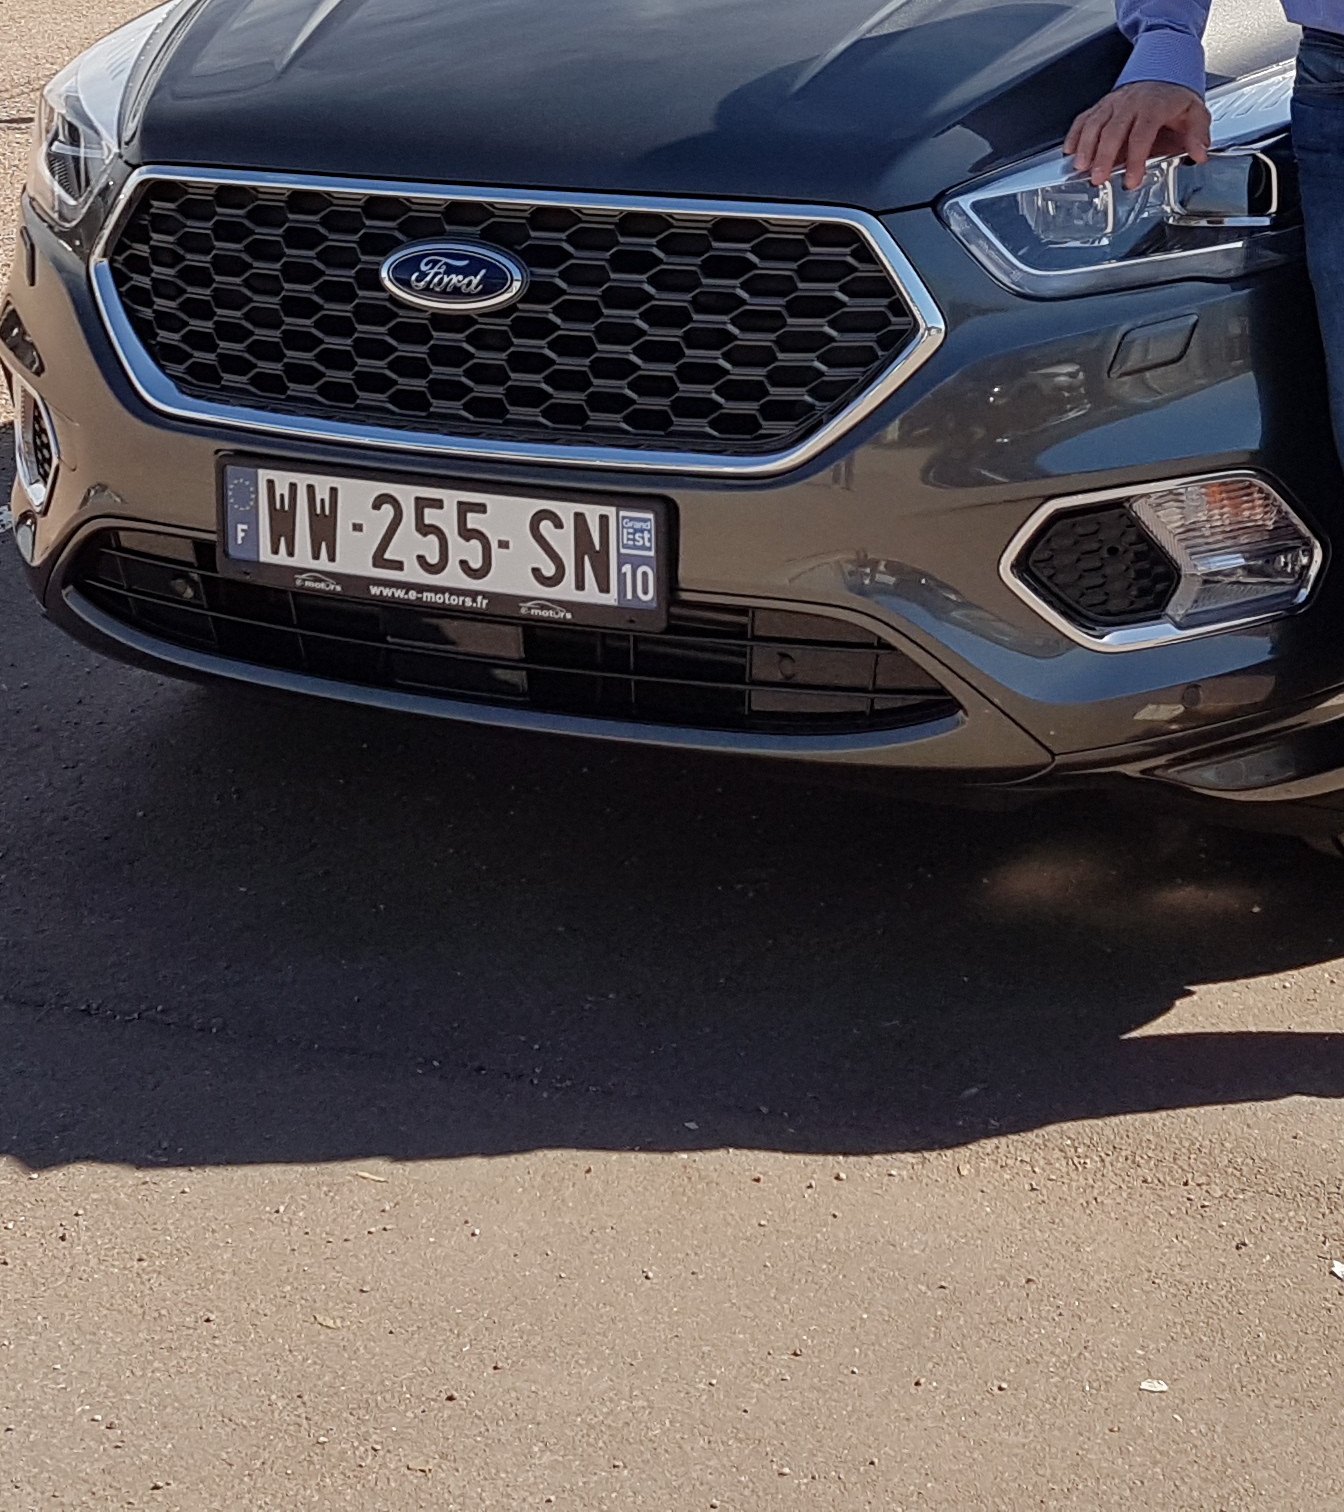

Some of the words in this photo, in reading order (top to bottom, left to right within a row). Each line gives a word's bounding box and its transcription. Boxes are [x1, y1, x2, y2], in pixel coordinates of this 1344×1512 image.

[411, 255, 488, 294] Ford
[237, 523, 249, 545] F
[622, 518, 651, 530] Grand
[622, 529, 651, 547] Est
[621, 563, 655, 602] 10
[369, 583, 489, 609] www.e-motors.fr
